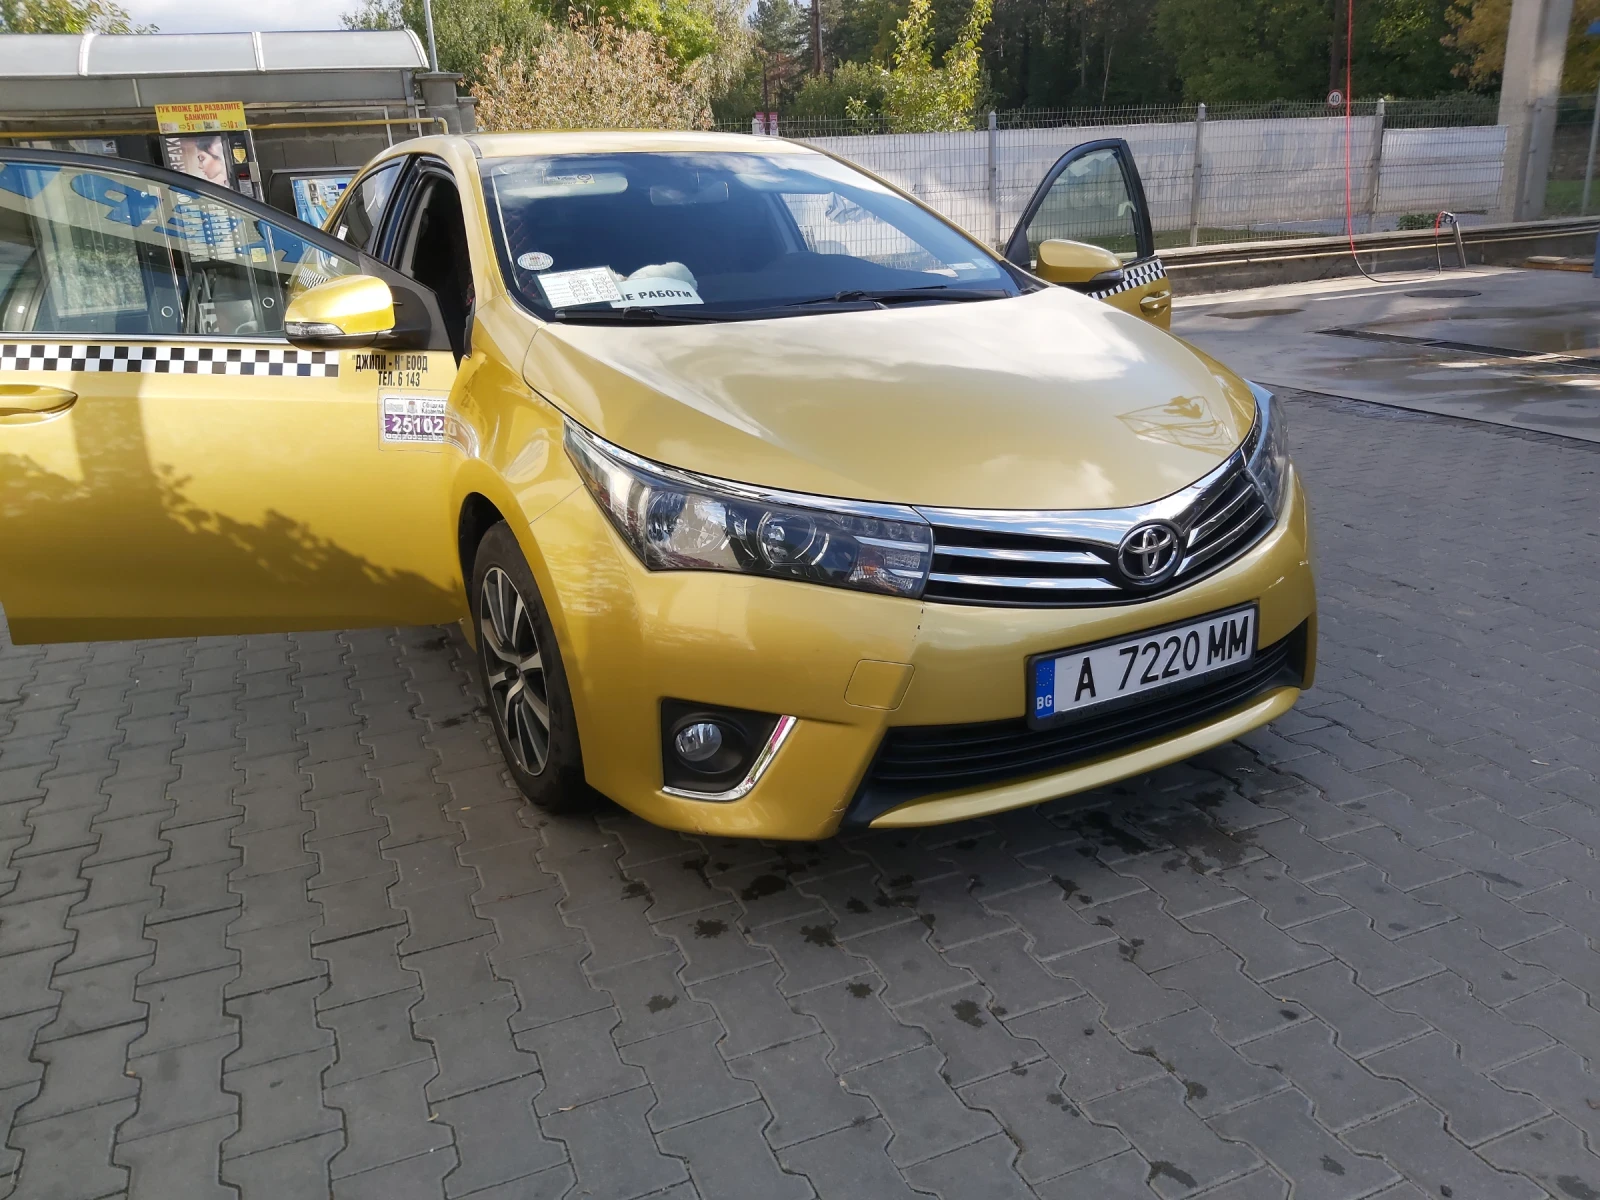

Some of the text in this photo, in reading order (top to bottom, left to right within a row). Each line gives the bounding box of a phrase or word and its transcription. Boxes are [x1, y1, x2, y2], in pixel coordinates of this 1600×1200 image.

[1330, 94, 1340, 103] 40
[194, 104, 203, 112] ДА
[204, 103, 240, 111] РАЗВАЛИТЕ
[184, 112, 217, 121] БАНКНОТИ
[638, 290, 692, 299] РАБОТИ
[406, 355, 428, 373] ЕООД
[378, 371, 420, 387] ТЕЛ. 6 143
[392, 416, 444, 434] 25102
[1074, 657, 1097, 702] A
[1118, 630, 1200, 691] 7220
[1207, 615, 1249, 666] MM
[1036, 694, 1052, 710] BG
